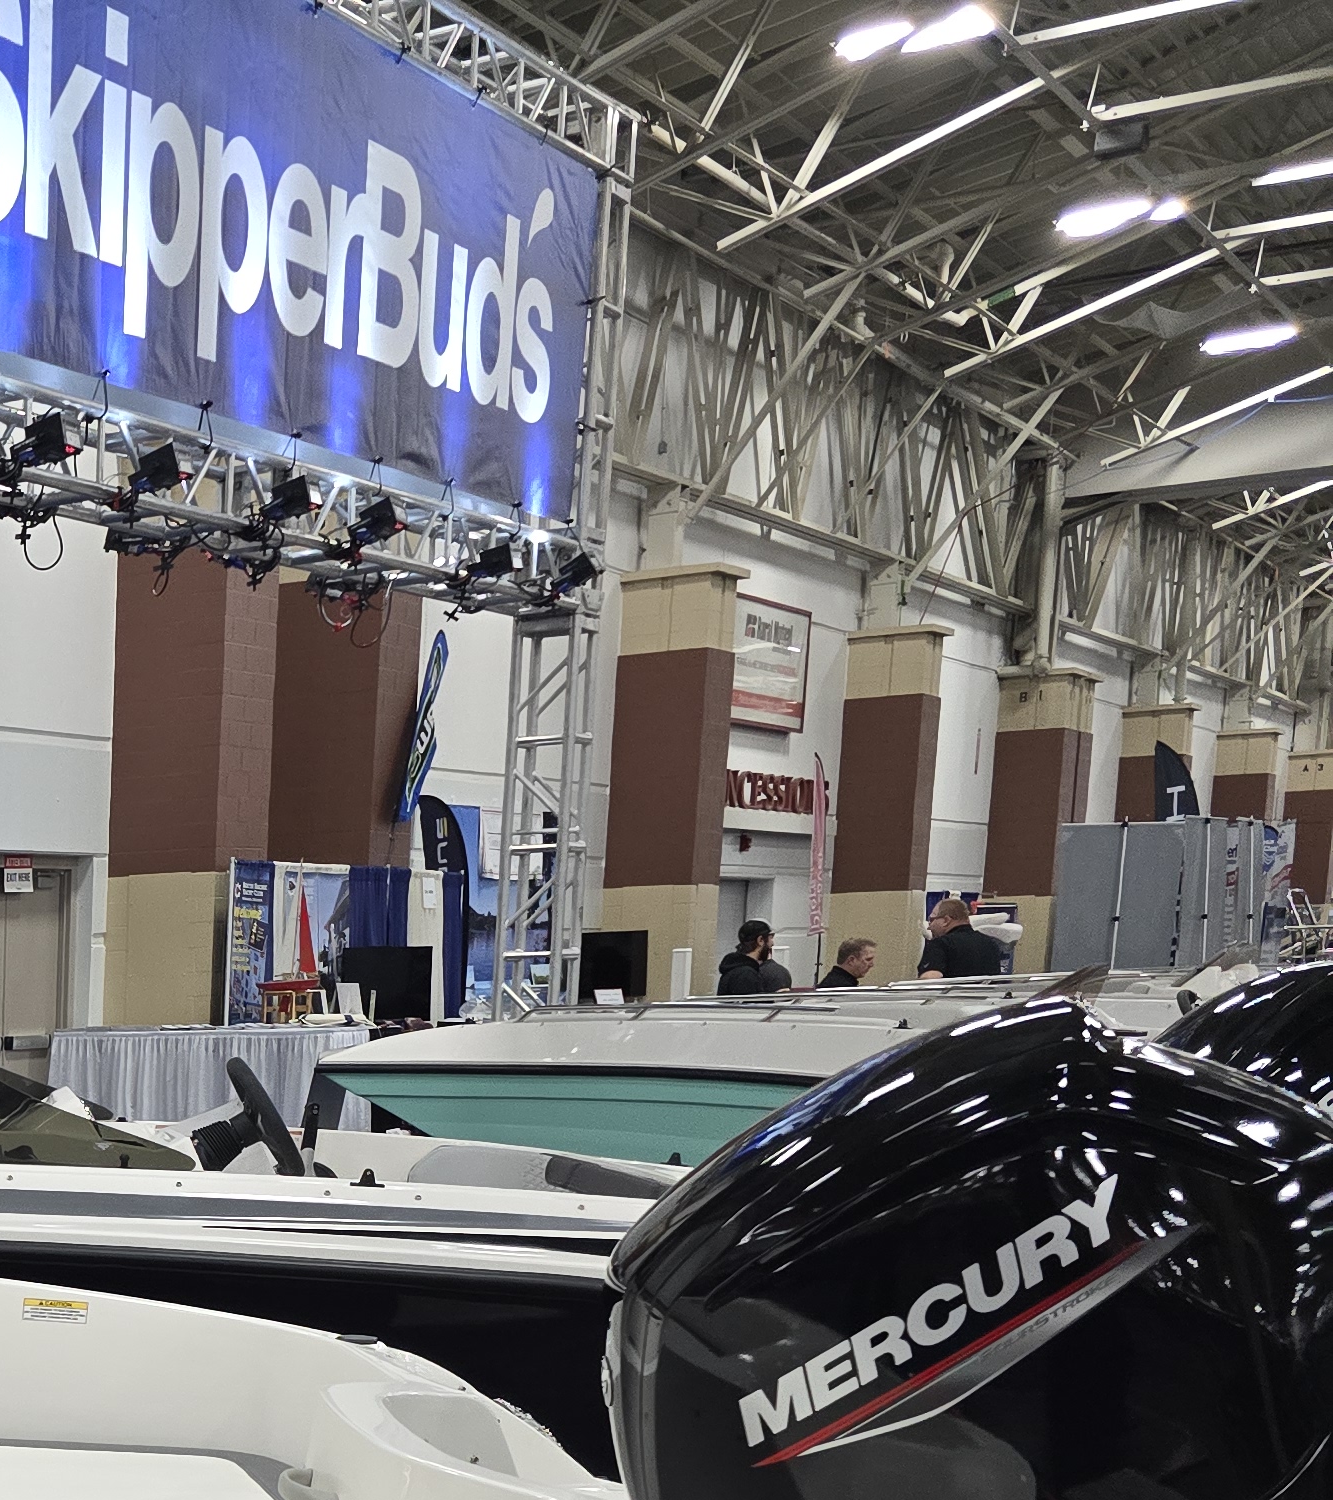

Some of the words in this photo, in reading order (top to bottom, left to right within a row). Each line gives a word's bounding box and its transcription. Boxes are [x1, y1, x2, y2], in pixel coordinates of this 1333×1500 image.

[6, 872, 17, 882] EXIT
[18, 872, 31, 882] HERE
[739, 1174, 1119, 1448] MERCURY
